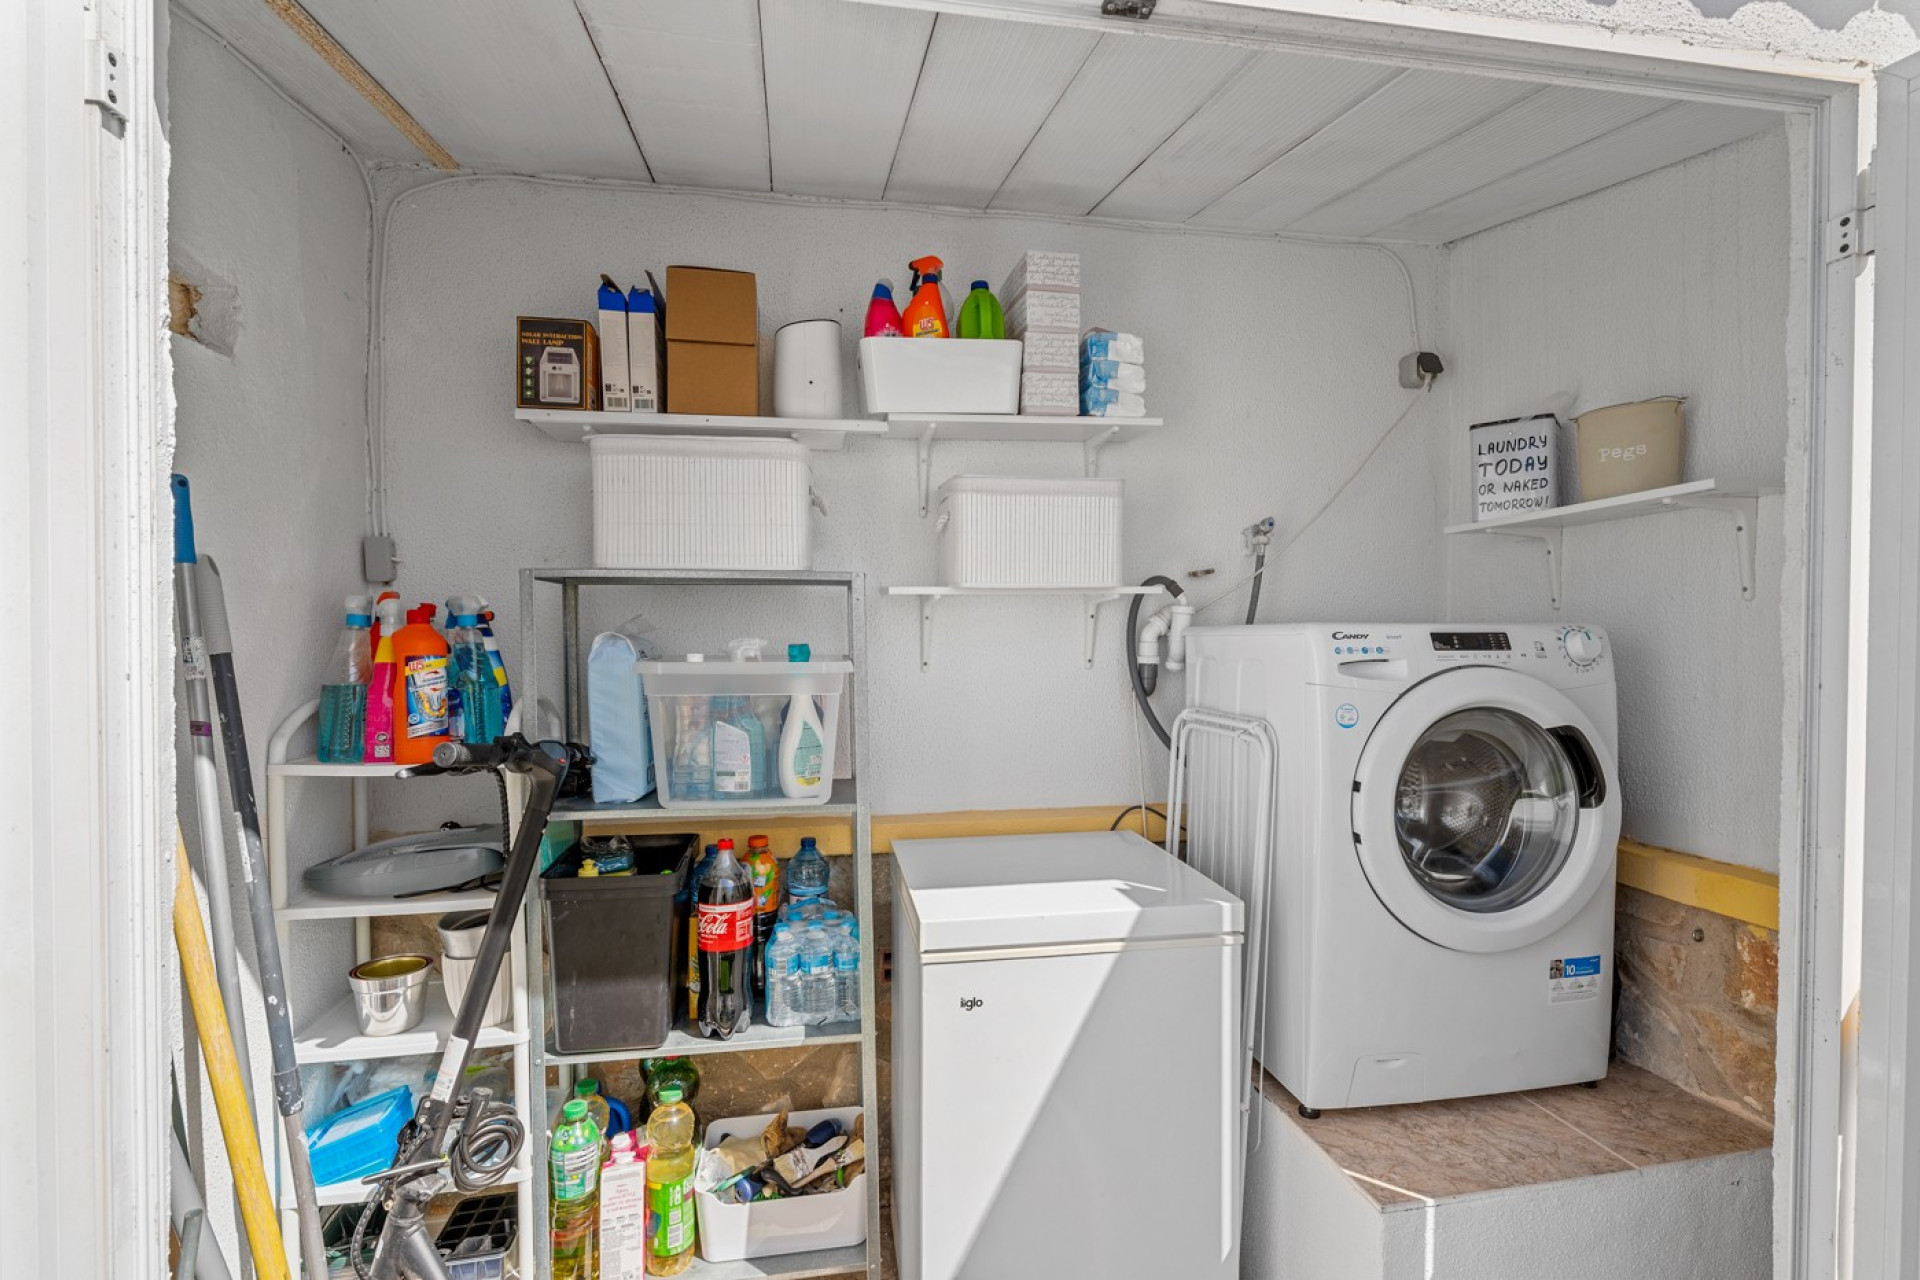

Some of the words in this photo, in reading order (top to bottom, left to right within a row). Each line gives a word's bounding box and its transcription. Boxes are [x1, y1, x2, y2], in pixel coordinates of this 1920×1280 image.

[543, 338, 564, 346] LAMP
[1478, 435, 1547, 456] LAUNDRY
[1478, 455, 1548, 477] TODAY
[1478, 482, 1496, 496] OR
[1503, 477, 1549, 493] NAKED
[1479, 495, 1550, 513] TOMORROW!
[1566, 964, 1576, 976] 10
